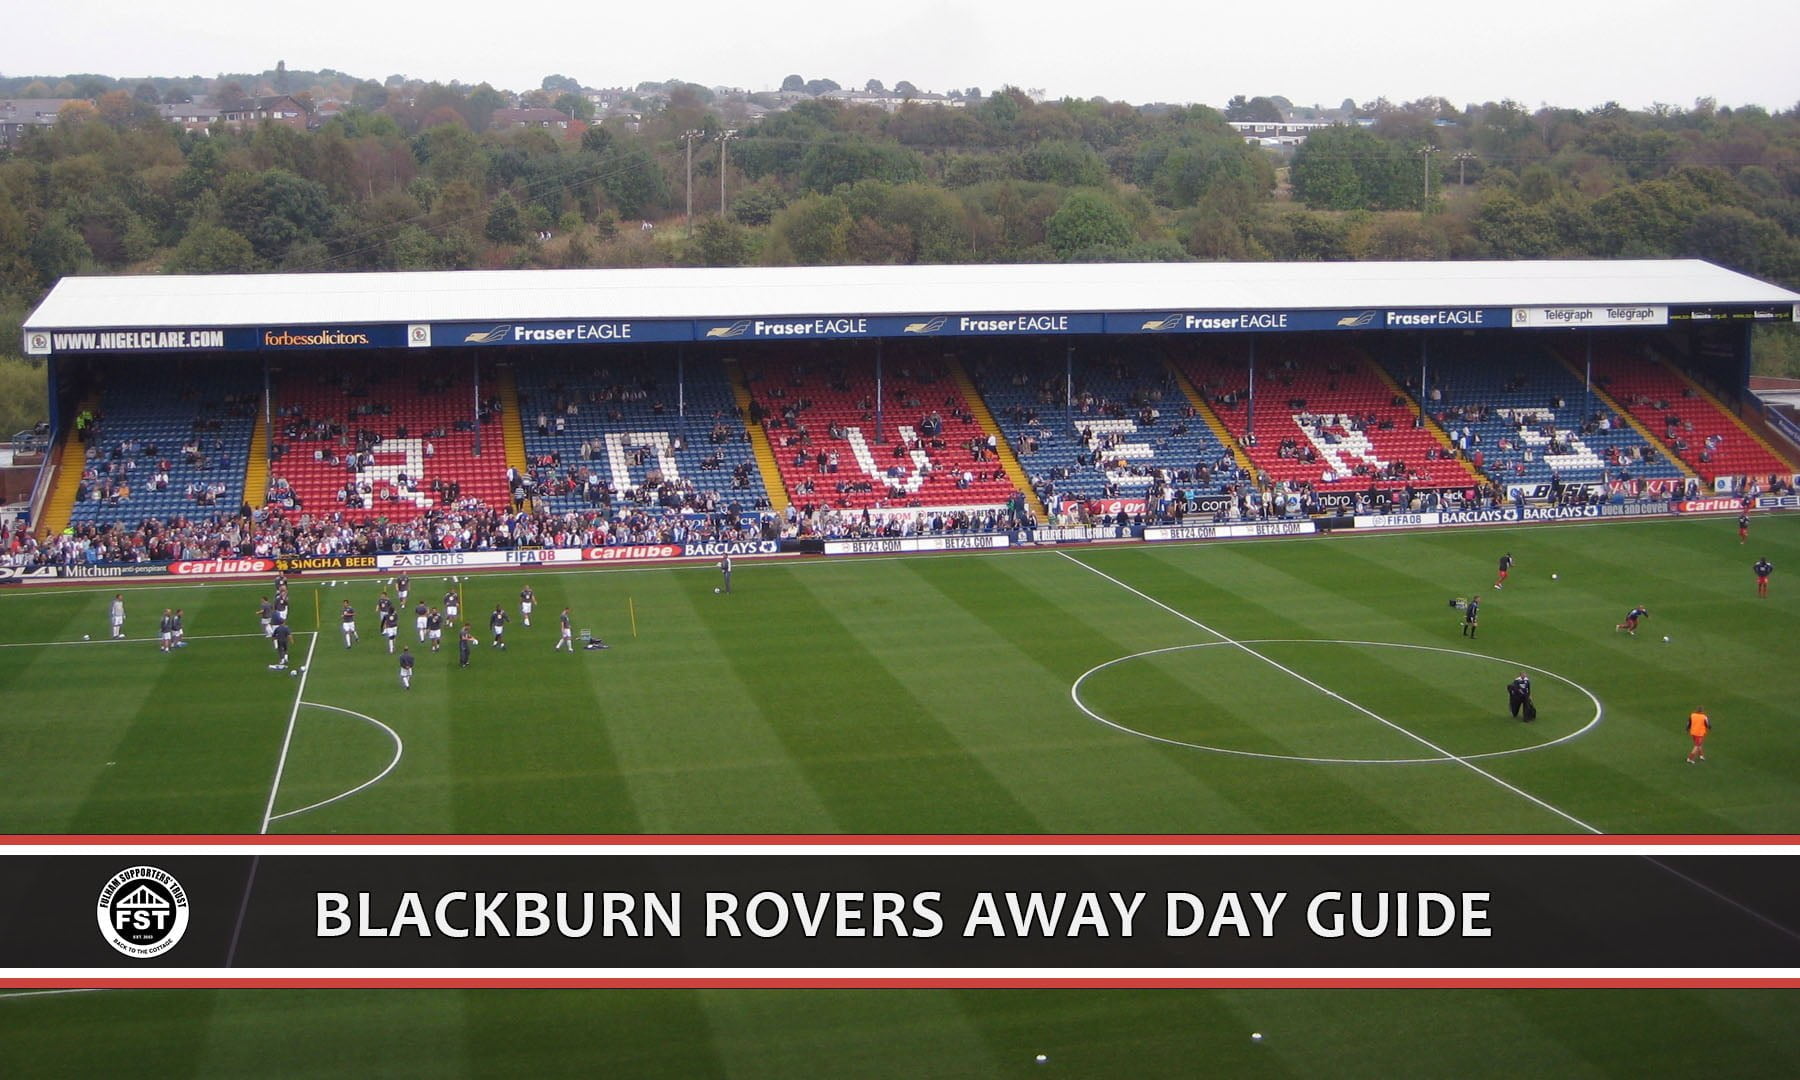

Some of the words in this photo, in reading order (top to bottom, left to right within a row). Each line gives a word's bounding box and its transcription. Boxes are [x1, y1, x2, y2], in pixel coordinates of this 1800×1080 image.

[1544, 309, 1593, 321] Telegraph
[1606, 308, 1654, 320] Telegraph
[53, 330, 225, 350] WWW.NIGELCLARE.COM
[1685, 500, 1744, 512] Carlub
[1441, 511, 1502, 525] BARCLAYS
[1523, 506, 1582, 520] BARCLAYS
[1387, 515, 1409, 526] FIFA
[1410, 514, 1422, 525] 08
[1170, 526, 1216, 539] BET24.COM
[1255, 523, 1300, 535] BET24.COM
[685, 541, 757, 556] BARCLAYS
[852, 541, 901, 553] BET24.COM
[944, 538, 993, 549] BET24.COM
[290, 559, 341, 570] SINGHA
[345, 556, 376, 568] BEER
[414, 553, 464, 566] SPORTS
[506, 551, 536, 563] FIFA
[538, 550, 556, 561] 08
[65, 564, 122, 578] Mitchum
